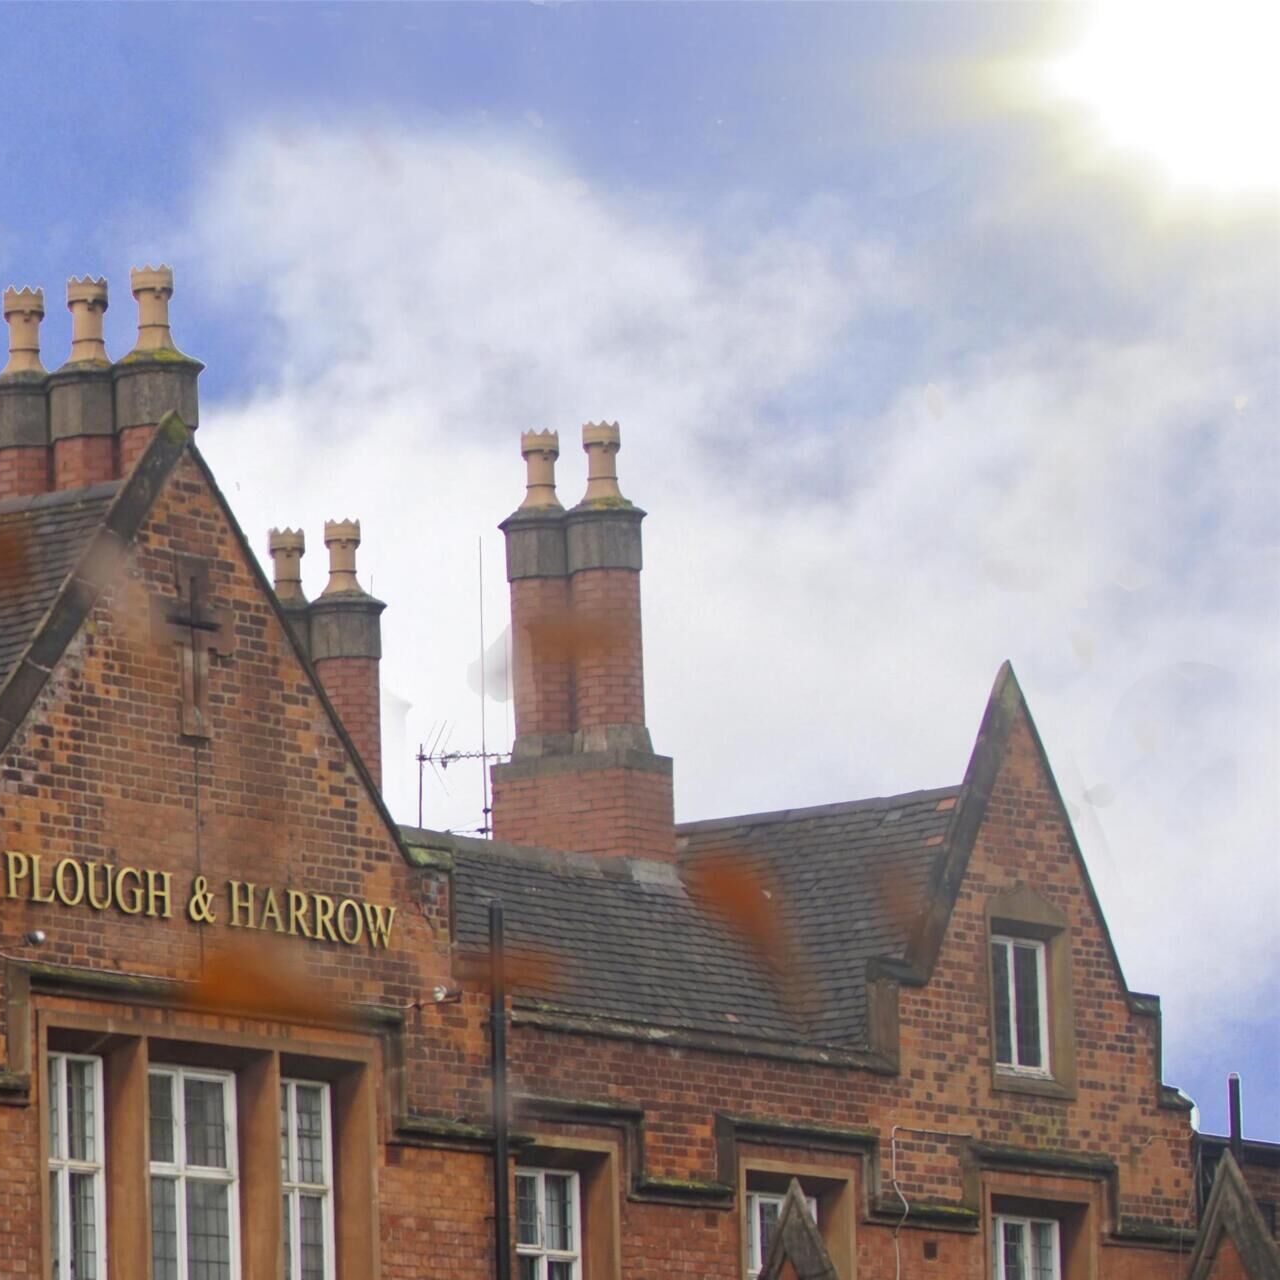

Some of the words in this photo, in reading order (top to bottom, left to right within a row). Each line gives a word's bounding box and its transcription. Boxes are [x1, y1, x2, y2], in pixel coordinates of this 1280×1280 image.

[4, 851, 173, 918] PLOUGH
[188, 875, 216, 924] &
[229, 881, 397, 949] HARROW
